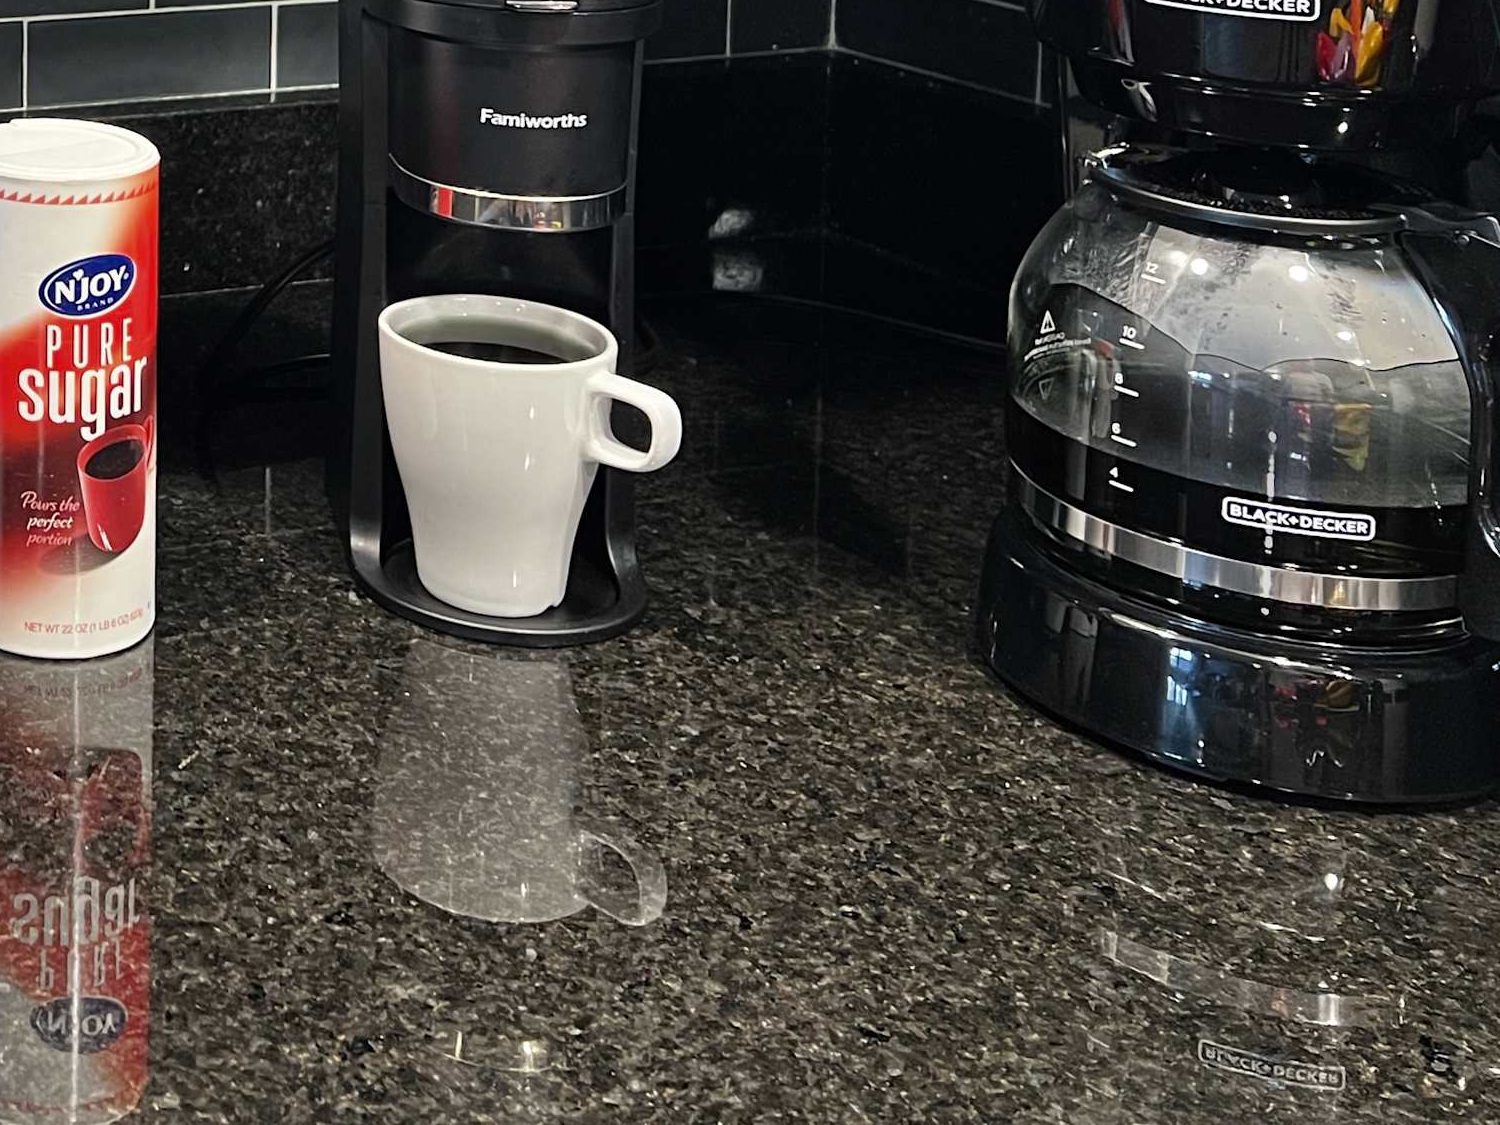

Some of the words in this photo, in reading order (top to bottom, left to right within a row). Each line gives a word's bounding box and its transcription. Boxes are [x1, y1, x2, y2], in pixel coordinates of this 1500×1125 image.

[479, 108, 588, 129] Famiworths
[1146, 261, 1159, 275] 12
[54, 265, 128, 306] N'JOY
[77, 296, 115, 312] BRAND
[1122, 325, 1138, 339] 10
[47, 317, 132, 369] PURE
[1114, 372, 1124, 385] 8
[18, 356, 148, 442] sugar
[1111, 422, 1122, 435] 6
[1108, 466, 1119, 478] 4
[20, 490, 58, 512] Pours
[59, 495, 80, 512] the
[26, 512, 74, 532] perfect
[1229, 503, 1369, 535] BLACK+DECKER
[26, 533, 73, 547] portion
[23, 621, 43, 633] NET
[44, 623, 60, 634] WT
[61, 624, 74, 635] 22
[75, 623, 89, 634] OZ
